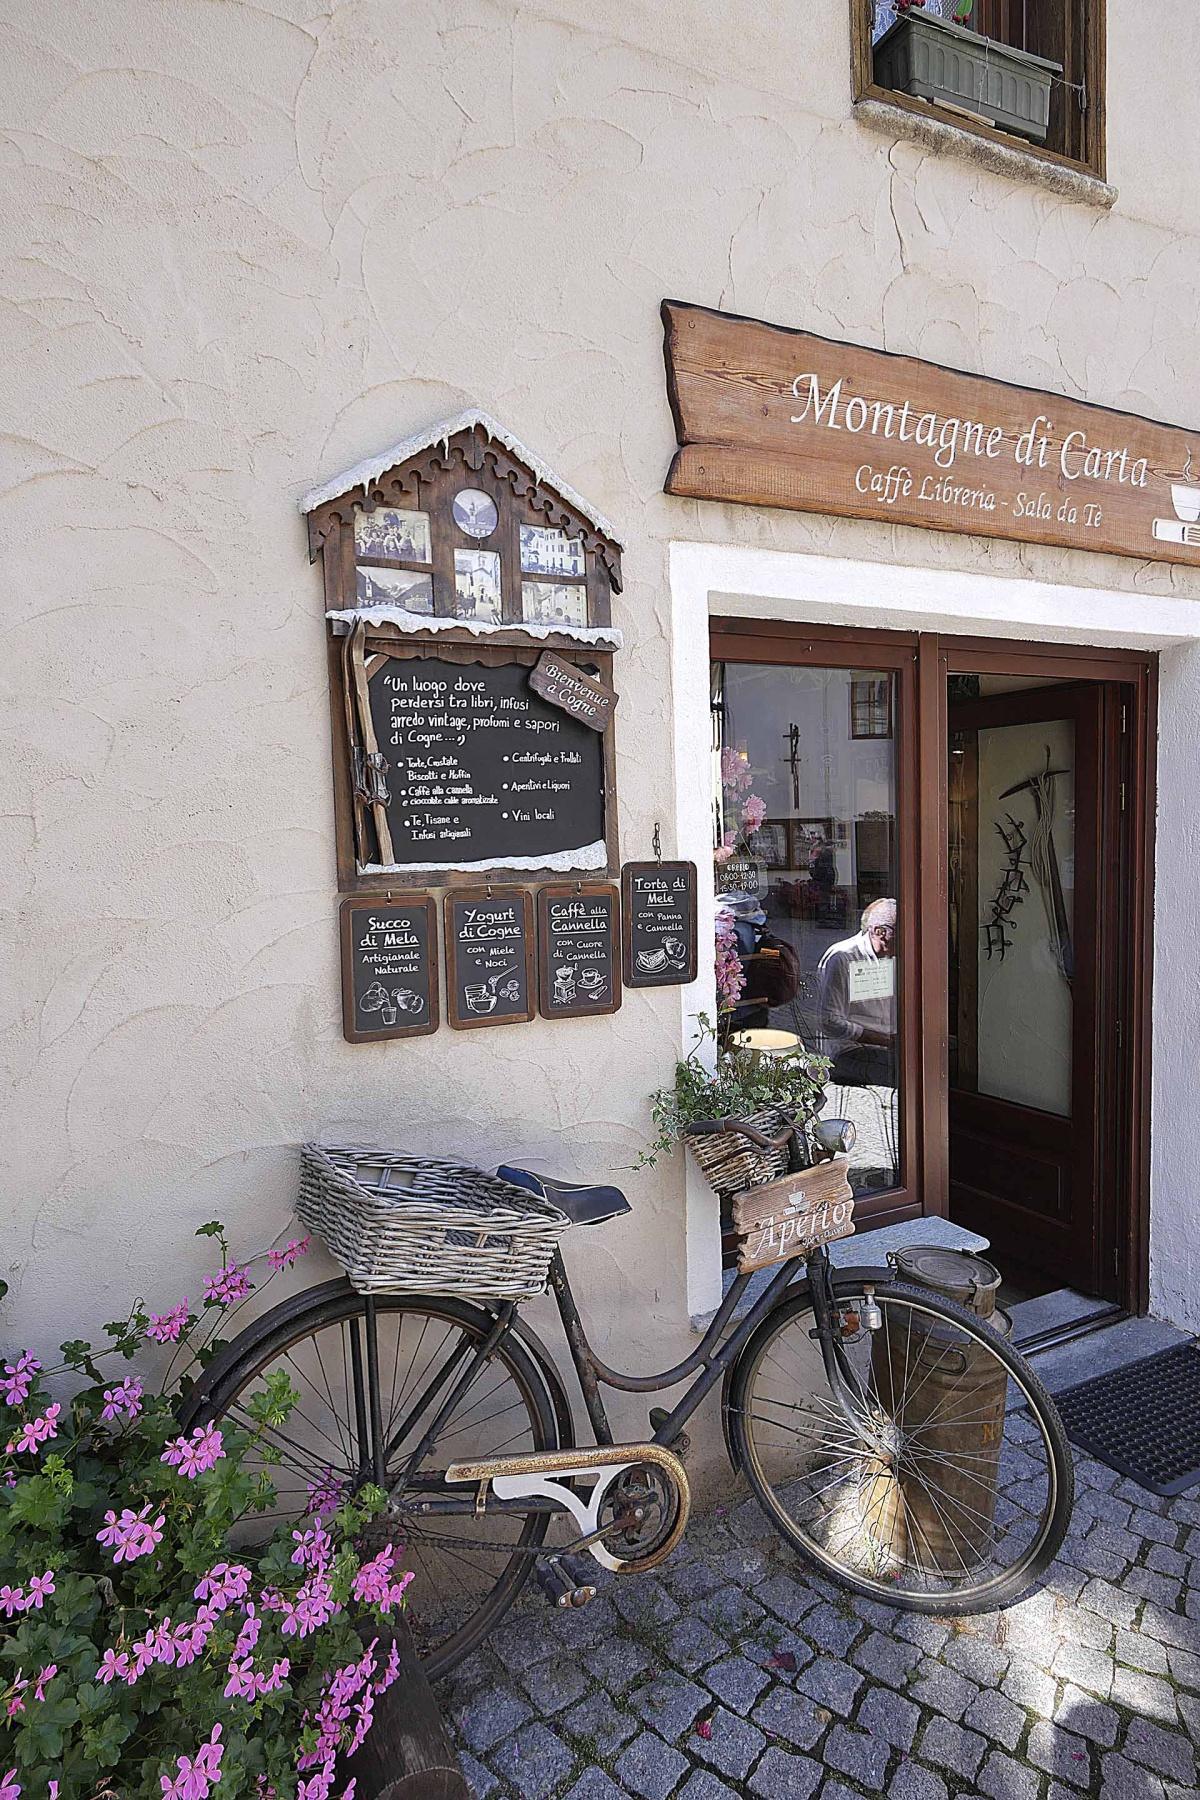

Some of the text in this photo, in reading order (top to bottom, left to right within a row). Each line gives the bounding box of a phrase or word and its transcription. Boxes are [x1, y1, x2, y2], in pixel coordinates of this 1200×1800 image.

[790, 373, 1149, 488] Montagne di Carta
[855, 464, 914, 504] Caffè
[917, 475, 996, 511] Libreria
[1012, 492, 1051, 520] Sala
[1057, 496, 1078, 524] da
[1083, 503, 1104, 528] Tè
[412, 675, 447, 699] luogo
[454, 676, 486, 692] dove
[545, 664, 609, 707] Bienvenue
[390, 693, 529, 712] perdersi tra libri, infusi
[546, 681, 597, 716] à Cogne
[390, 711, 560, 734] arredo vintage, profumi e sapori
[390, 731, 403, 745] di
[406, 770, 438, 781] Biscotti
[408, 785, 430, 797] Caffè
[431, 785, 444, 795] alla
[547, 779, 570, 793] Liquori
[424, 813, 451, 825] Tisane
[453, 816, 460, 824] e
[512, 808, 555, 822] Vini locali
[411, 829, 436, 840] Infusi
[634, 876, 686, 890] Torta di
[647, 892, 675, 905] Mele
[464, 907, 515, 925] Yogurt
[551, 902, 608, 919] Caffè alla
[638, 911, 683, 921] con Panna
[368, 916, 411, 931] Succo
[551, 918, 607, 932] Cannella
[645, 922, 684, 933] Cannella
[360, 931, 419, 947] di Mela
[459, 924, 522, 940] di Cogne
[466, 945, 516, 957] con Miele
[576, 940, 603, 949] Cuore
[362, 950, 421, 965] Artigianale
[553, 949, 607, 961] di Cannella
[374, 963, 419, 976] Naturale
[485, 958, 508, 968] Noci
[750, 1202, 846, 1259] Aperto
